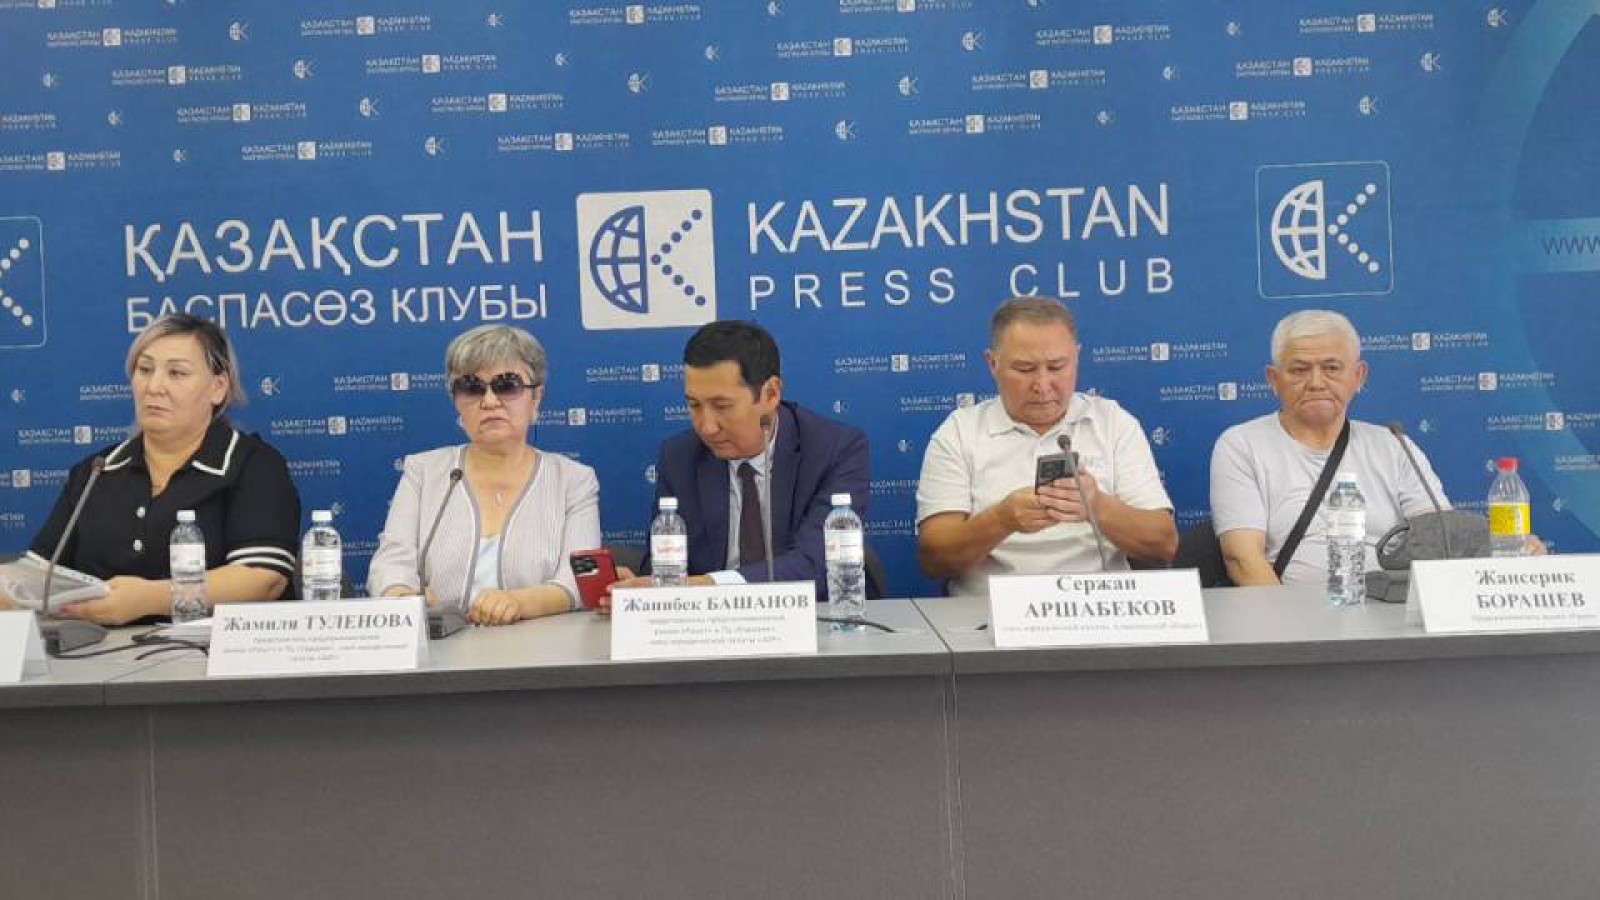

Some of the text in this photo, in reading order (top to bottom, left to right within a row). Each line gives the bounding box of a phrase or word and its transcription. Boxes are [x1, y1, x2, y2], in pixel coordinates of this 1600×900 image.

[747, 183, 1170, 254] KAZAKHSTAN
[124, 210, 543, 283] ҚАЗАҚСТАН
[749, 257, 1174, 311] PRESS CLUB
[127, 284, 548, 333] БАСПАСӨЗ КЛУБЫ
[1056, 575, 1136, 595] Сержан
[1475, 569, 1576, 588] Жансерик
[623, 594, 809, 612] Жанибек БАШАНОВ
[1025, 599, 1176, 618] АРШАБЕКОВ
[1476, 591, 1586, 609] БОРАШЕВ
[224, 613, 413, 632] Жамиля ТУЛЕНОВА
